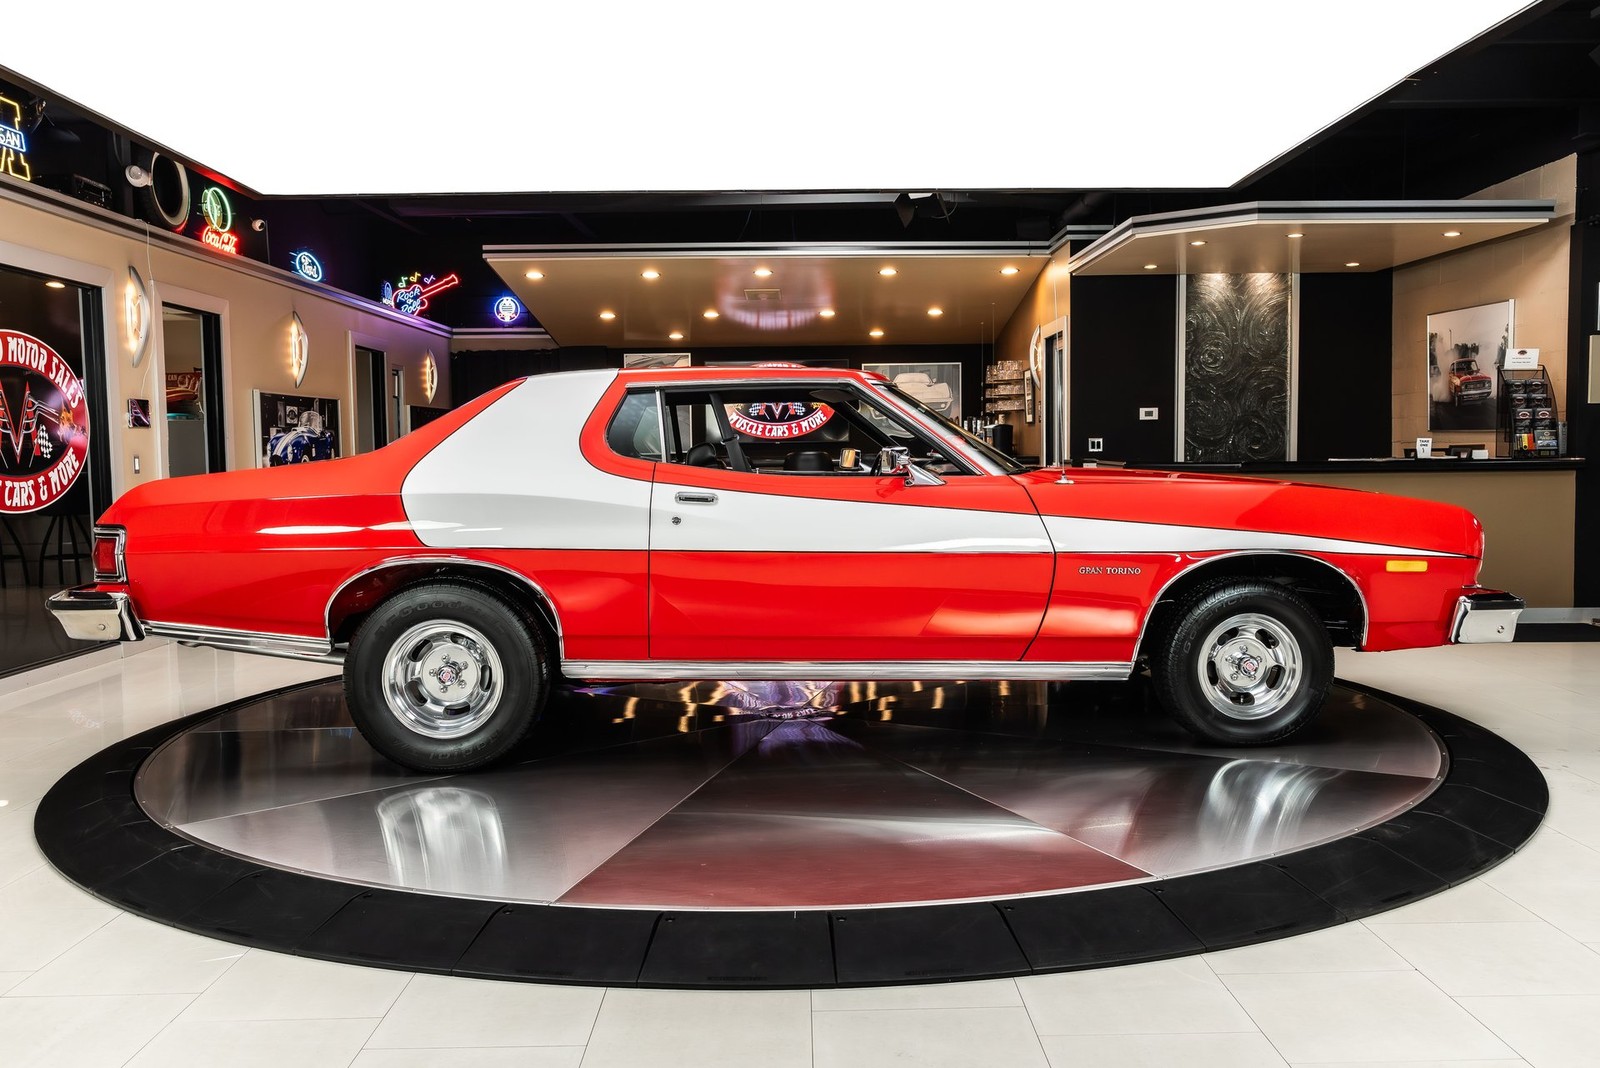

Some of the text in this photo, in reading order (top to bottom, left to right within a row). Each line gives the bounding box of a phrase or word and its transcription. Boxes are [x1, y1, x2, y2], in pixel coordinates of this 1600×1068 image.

[397, 286, 420, 302] Rock
[7, 336, 47, 373] MOTOR
[49, 355, 82, 409] SALES
[729, 410, 827, 437] MUSCLE CARS & MORE
[5, 447, 79, 507] CARS & MORE
[1079, 566, 1141, 575] GRAN TORINO
